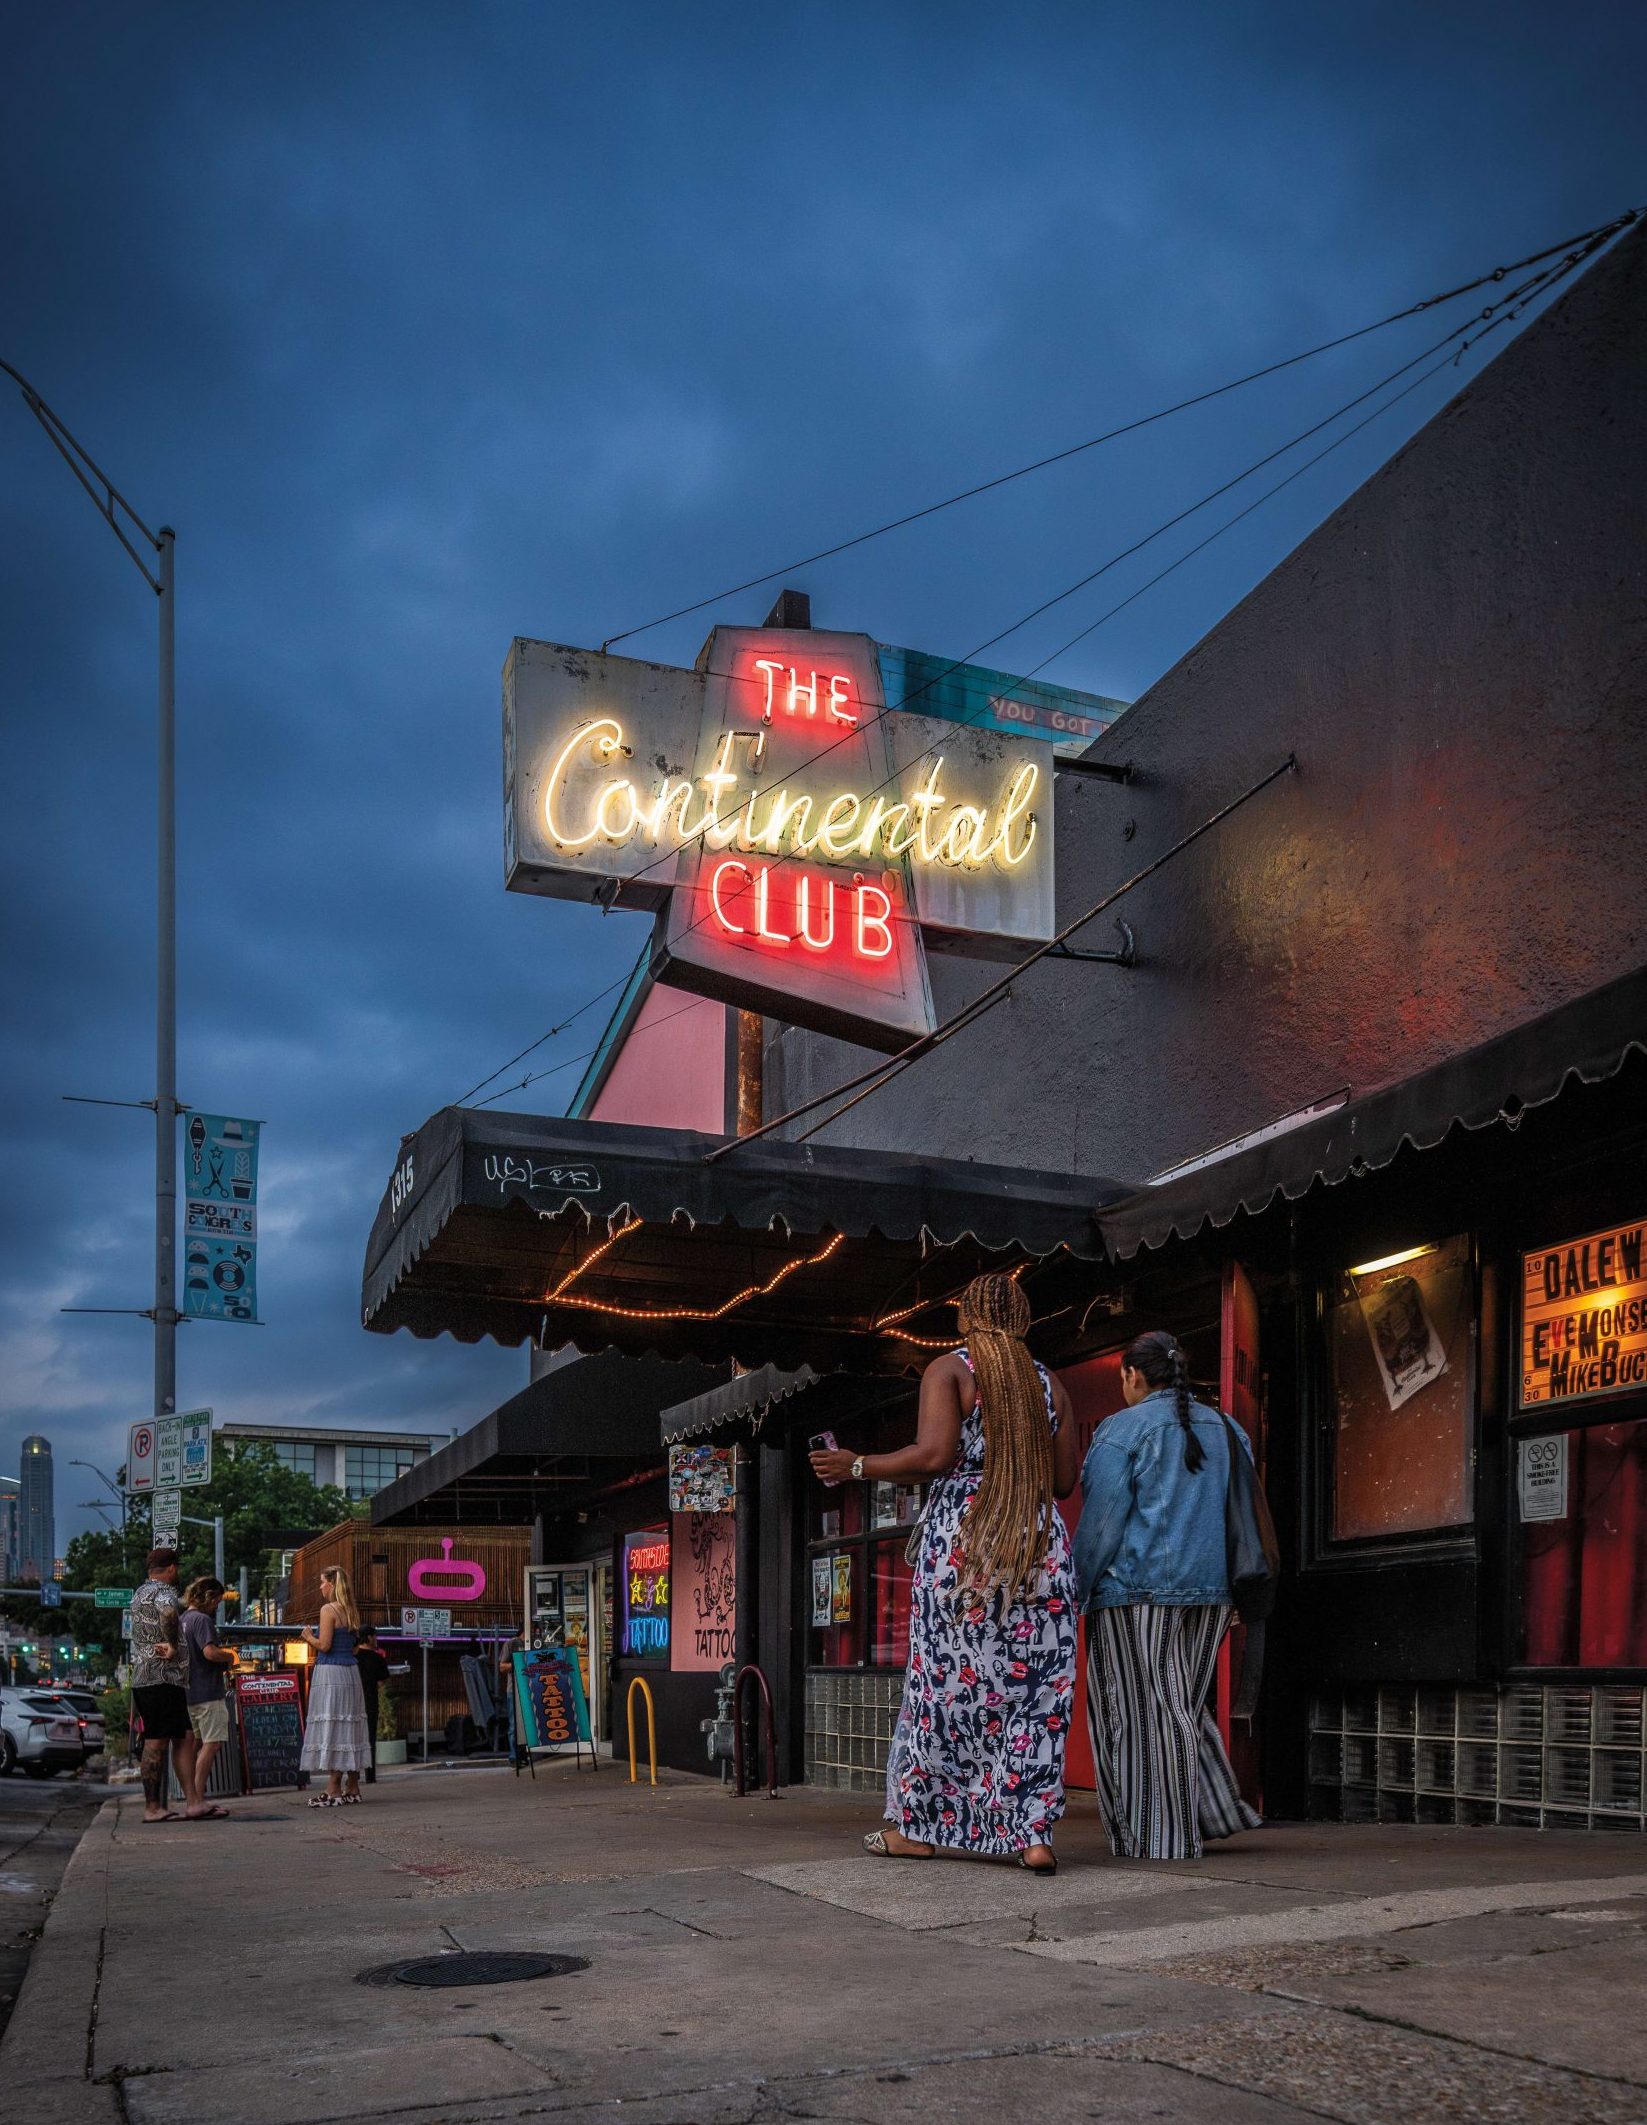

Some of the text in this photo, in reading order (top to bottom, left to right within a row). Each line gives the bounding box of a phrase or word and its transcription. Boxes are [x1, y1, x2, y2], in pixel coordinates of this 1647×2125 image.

[755, 658, 858, 725] THE
[989, 696, 1092, 736] YOU GOT
[544, 718, 1039, 865] Continental
[712, 861, 893, 958] CLUB
[189, 1202, 252, 1219] SOUTH
[188, 1214, 253, 1232] CONGRESS
[1526, 1260, 1541, 1273] 10
[1550, 1339, 1647, 1398] MIKE BUC
[1524, 1375, 1531, 1385] 6
[1524, 1390, 1540, 1402] 30
[158, 1447, 180, 1459] PARKING
[162, 1462, 175, 1472] ONLY
[628, 1617, 668, 1654] TATTOO
[242, 1680, 293, 1690] CONTINENTAL
[243, 1692, 295, 1703] GALLERY
[538, 1673, 570, 1741] TATTOO
